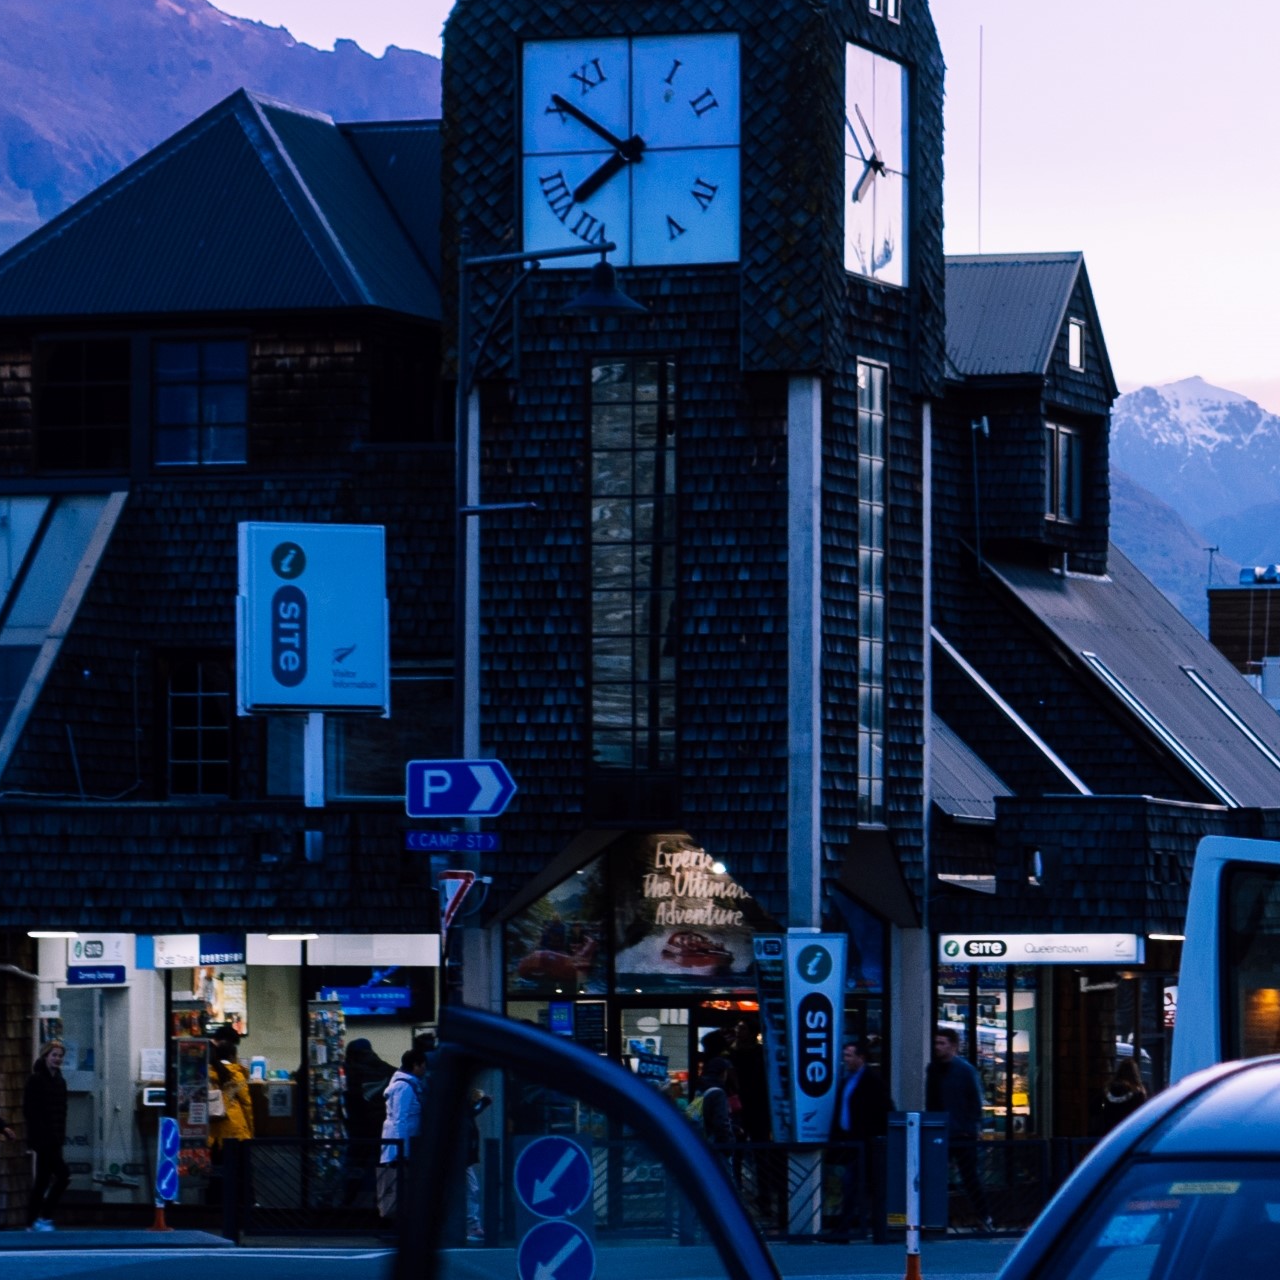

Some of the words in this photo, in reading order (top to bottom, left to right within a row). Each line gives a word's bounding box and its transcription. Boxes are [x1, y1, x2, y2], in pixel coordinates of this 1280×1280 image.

[569, 57, 608, 96] XI
[663, 59, 682, 86] I
[688, 87, 720, 118] II
[538, 169, 577, 225] VIII
[690, 176, 719, 213] IV
[665, 214, 689, 241] V
[423, 768, 453, 809] P
[419, 832, 460, 848] CAMP
[465, 834, 484, 848] ST
[655, 840, 714, 876] Experie
[642, 872, 671, 899] The
[654, 899, 744, 927] Adventure
[1024, 942, 1090, 955] Queenstown
[640, 1061, 668, 1077] OPEN
